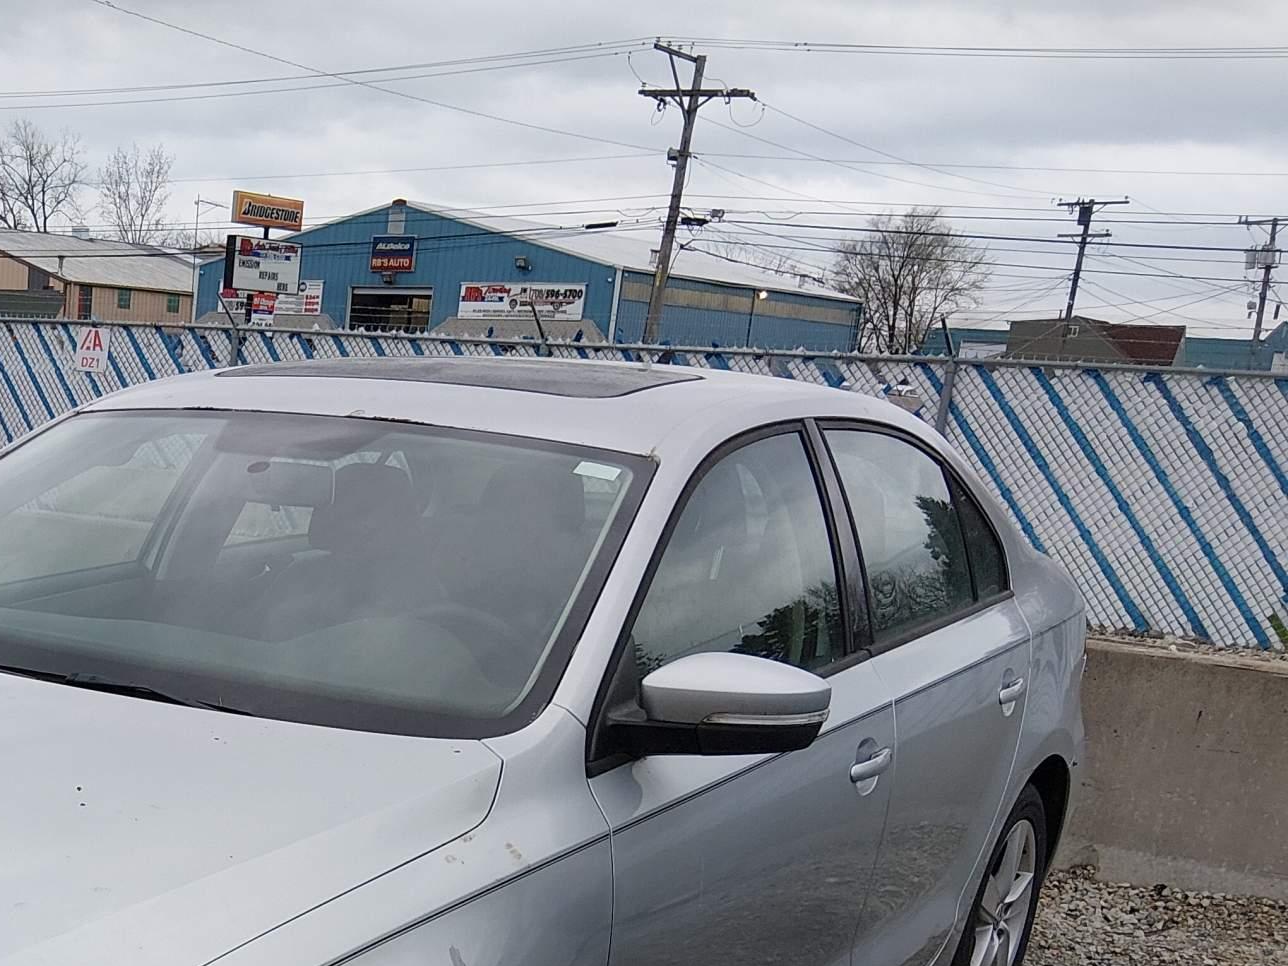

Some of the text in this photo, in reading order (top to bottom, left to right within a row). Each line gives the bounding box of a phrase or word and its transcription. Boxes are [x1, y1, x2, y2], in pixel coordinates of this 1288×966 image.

[242, 200, 300, 223] BRIDGESTONE
[239, 259, 261, 269] EMISSION
[389, 258, 410, 267] AUTO
[259, 271, 279, 281] REPAIRS
